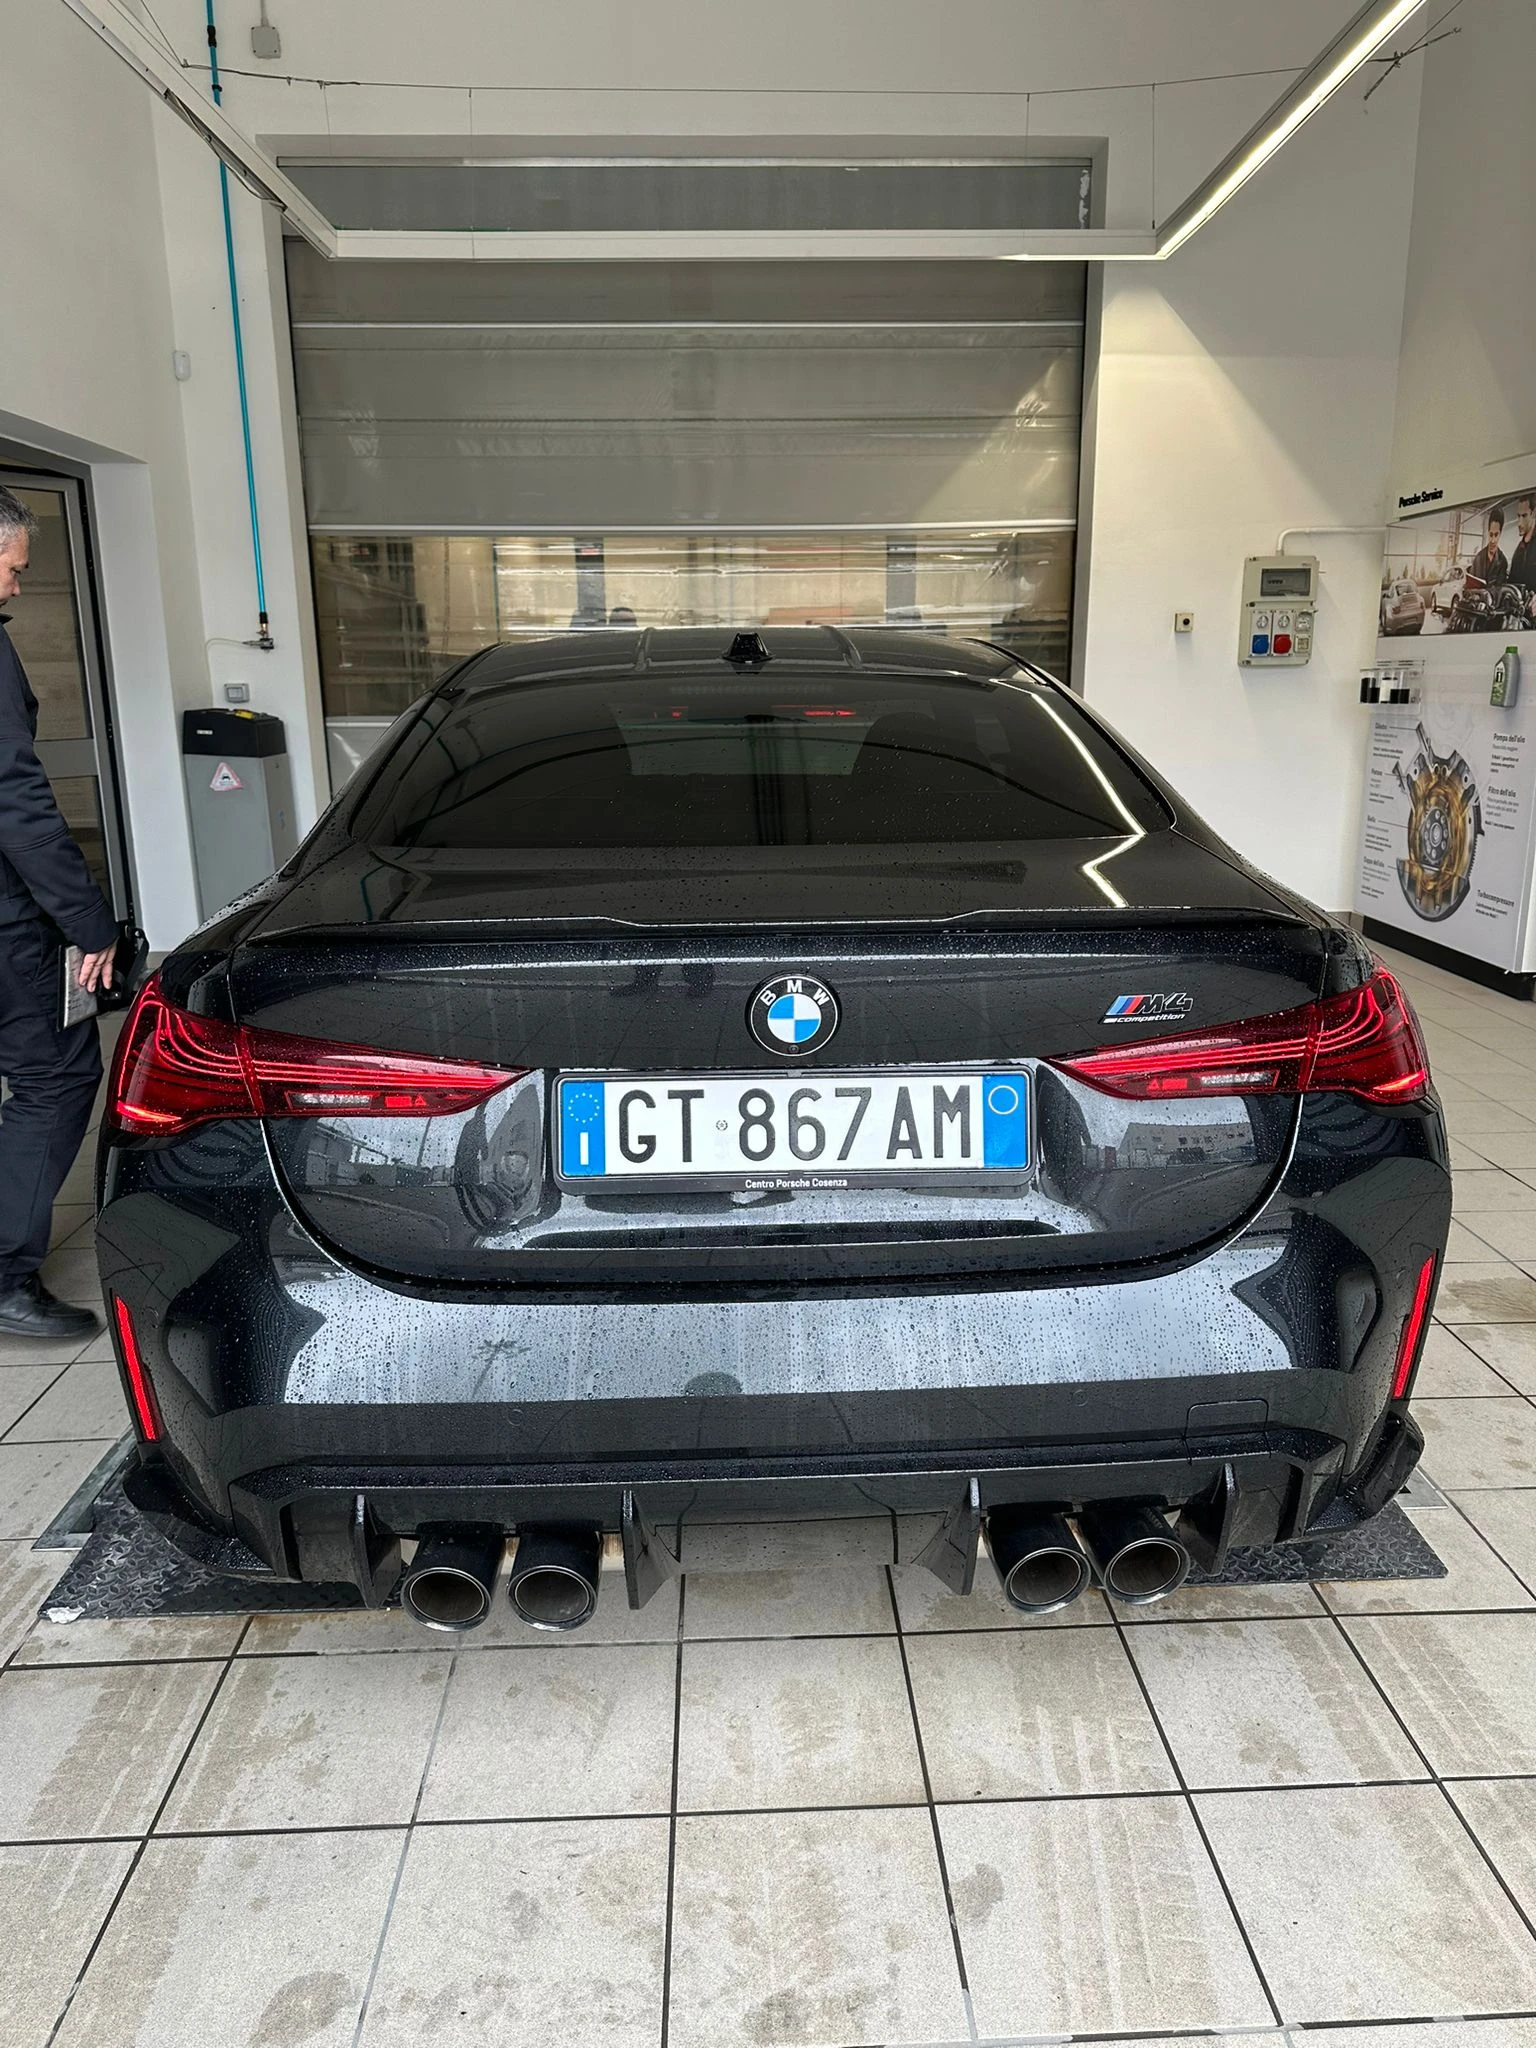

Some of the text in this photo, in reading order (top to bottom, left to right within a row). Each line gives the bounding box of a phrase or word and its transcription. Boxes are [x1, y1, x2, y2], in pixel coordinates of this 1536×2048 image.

[1399, 488, 1443, 508] Porsche Service
[760, 979, 830, 1006] BMW
[1134, 992, 1194, 1015] M4
[1117, 1013, 1186, 1023] competition
[618, 1088, 705, 1164] GT
[745, 1177, 848, 1189] Centro Porsche Cosenza
